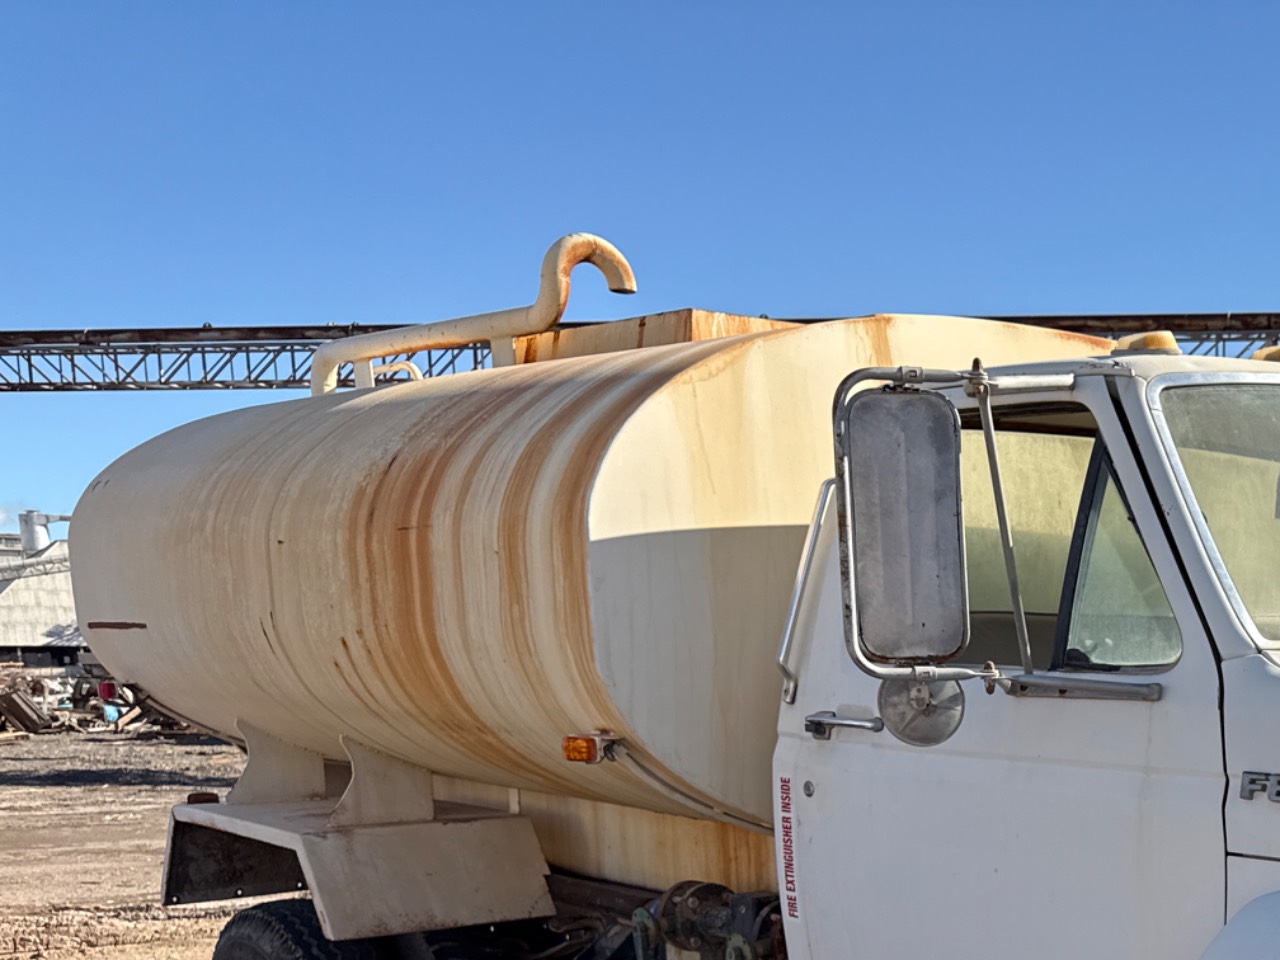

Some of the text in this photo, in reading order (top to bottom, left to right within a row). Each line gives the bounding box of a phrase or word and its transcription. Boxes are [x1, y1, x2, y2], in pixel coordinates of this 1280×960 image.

[780, 777, 798, 918] FIRE EXTINGUISHER INSIDE
